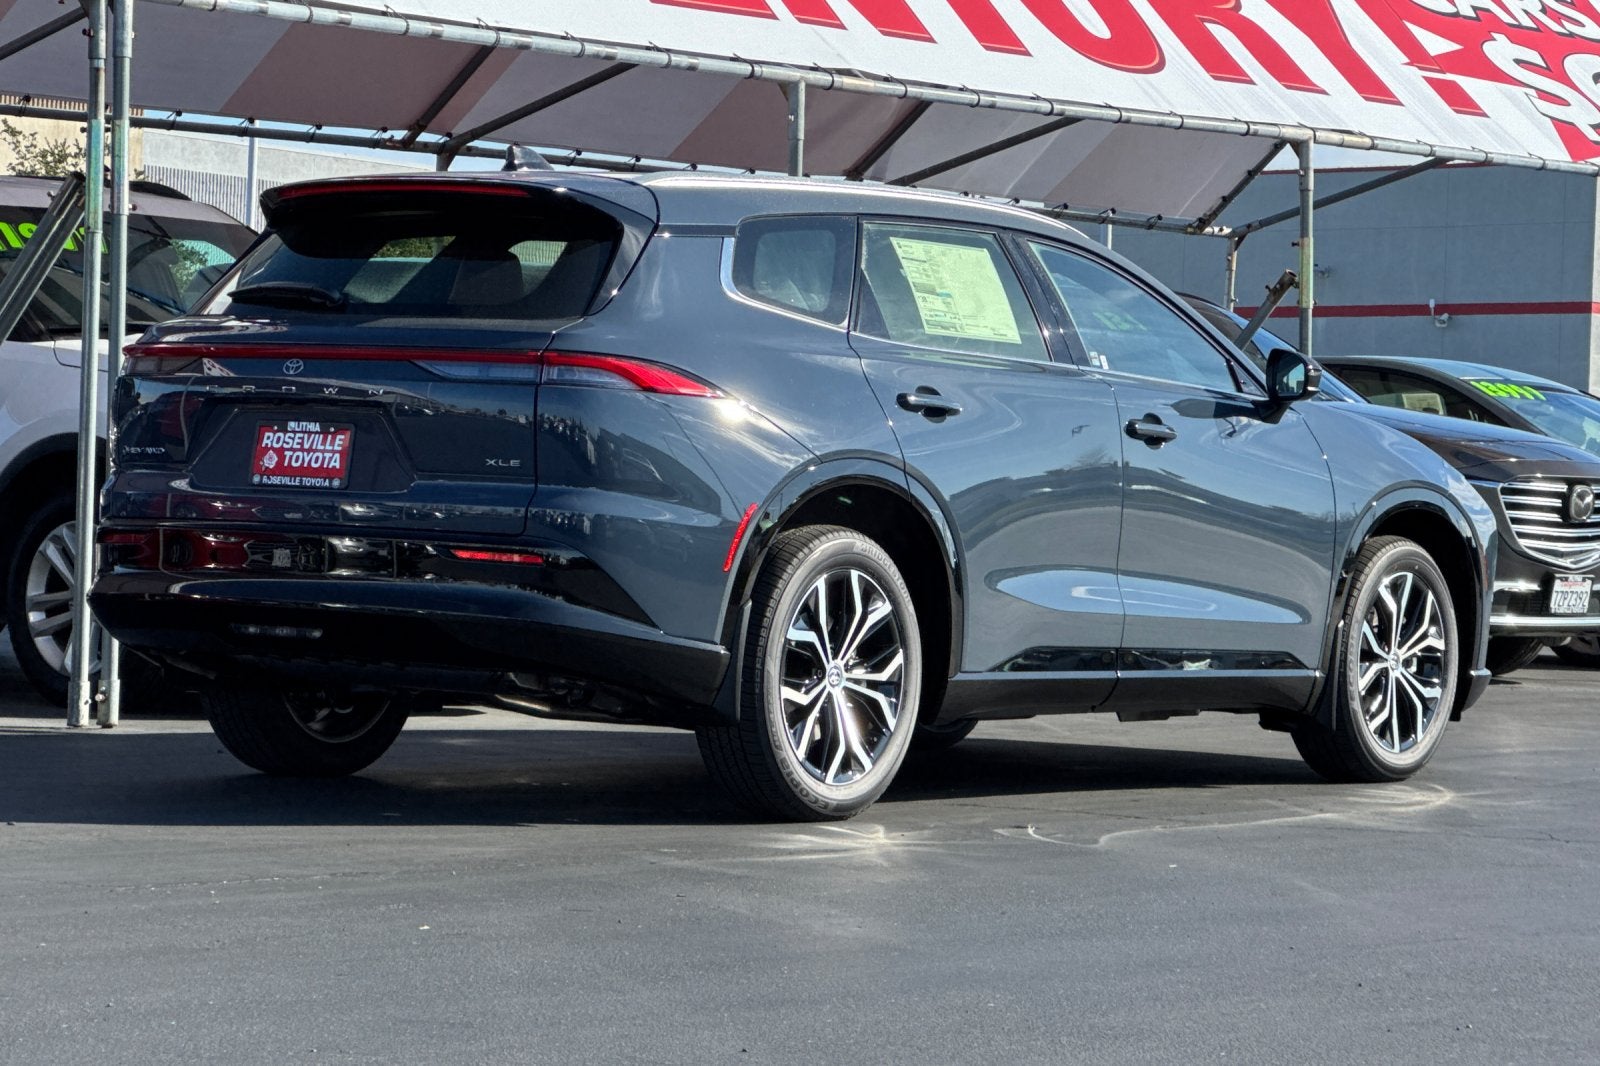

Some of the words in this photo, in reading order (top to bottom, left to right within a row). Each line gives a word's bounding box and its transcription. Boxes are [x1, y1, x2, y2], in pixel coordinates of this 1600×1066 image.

[295, 421, 321, 432] LITHIA
[262, 432, 345, 450] ROSEVILLE
[283, 451, 340, 469] TOYOTA
[485, 458, 521, 467] XLE
